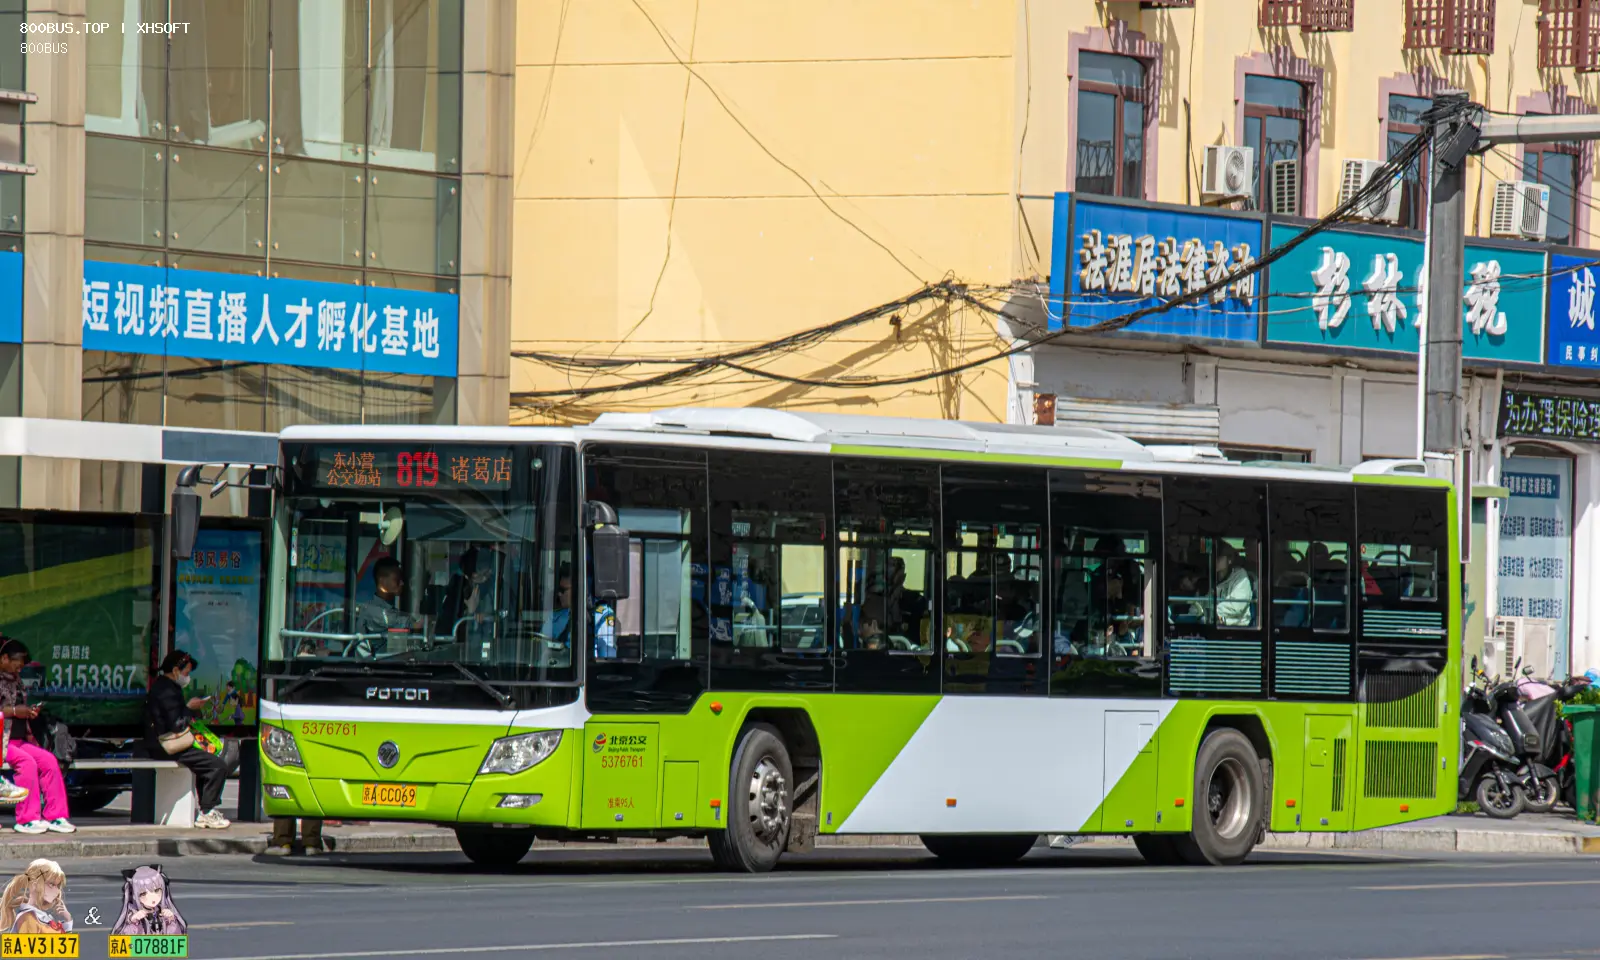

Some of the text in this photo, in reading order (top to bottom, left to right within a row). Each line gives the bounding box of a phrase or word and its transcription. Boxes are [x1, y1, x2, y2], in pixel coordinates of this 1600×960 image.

[1311, 246, 1508, 335] 杉林税
[1568, 266, 1596, 331] 诚
[82, 278, 440, 358] 短视频直播人才孵化基地
[334, 452, 375, 470] 东小营
[396, 452, 439, 487] 819
[451, 456, 512, 484] 诸葛店
[327, 469, 382, 487] 公交场站
[194, 551, 241, 569] 移风易俗
[51, 664, 137, 691] 3153367
[366, 686, 430, 701] FOTON
[301, 721, 358, 737] 5376761
[609, 735, 647, 745] 北京公交
[601, 755, 643, 769] 5376761
[607, 796, 635, 809] 准乘95人
